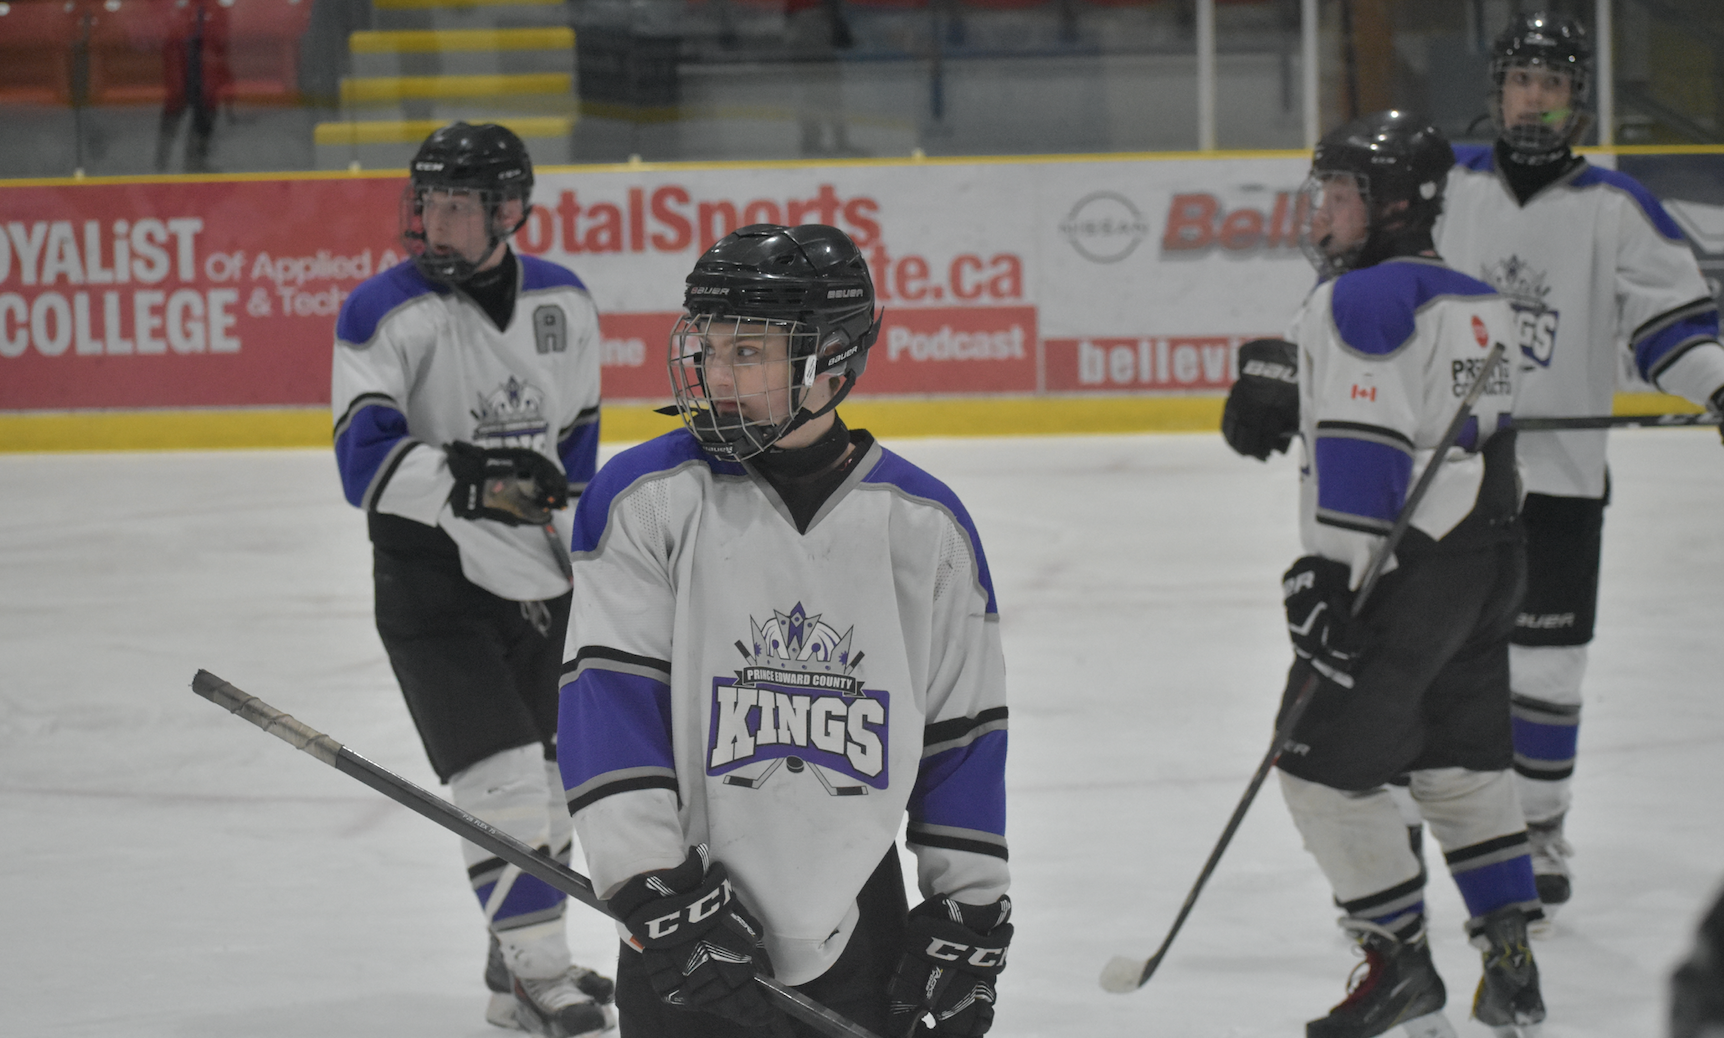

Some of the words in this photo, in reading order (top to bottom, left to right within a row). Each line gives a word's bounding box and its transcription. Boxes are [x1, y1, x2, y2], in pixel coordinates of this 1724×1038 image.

[515, 184, 881, 257] otalSports
[1059, 219, 1148, 236] NISSAN
[1159, 192, 1312, 260] Bell
[0, 217, 203, 285] YALiST
[250, 249, 372, 287] Applied
[690, 286, 730, 296] BAUER
[869, 246, 1023, 300] te.ca
[277, 285, 347, 317] Tech
[827, 288, 864, 299] BAUER
[0, 288, 241, 357] COLLEGE
[532, 303, 568, 354] A
[827, 345, 859, 367] BAUER
[886, 324, 1025, 360] Podcast
[1078, 336, 1240, 384] bellevi
[1242, 358, 1298, 385] BAU
[1515, 611, 1575, 629] AUER
[747, 669, 775, 682] PRINCE
[774, 671, 811, 686] EDWARD
[812, 674, 853, 690] COUNTY
[710, 685, 886, 778] KINGS
